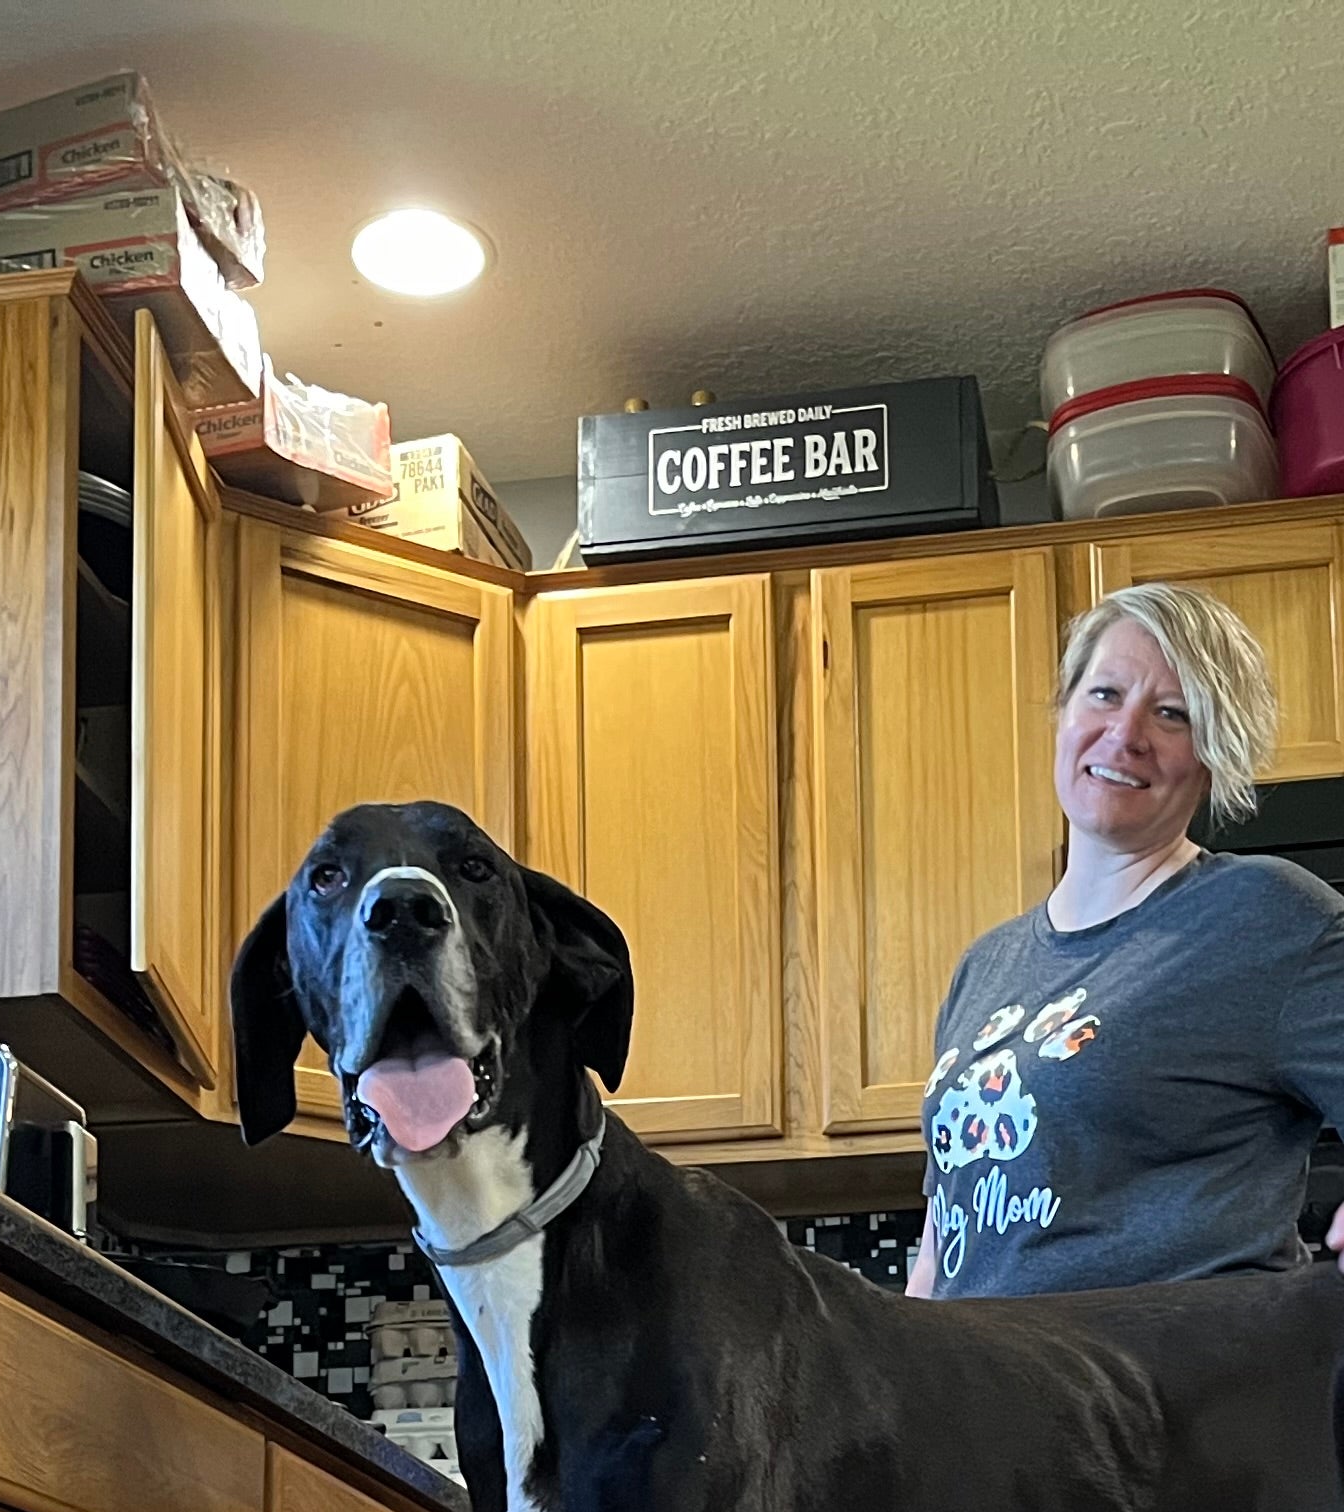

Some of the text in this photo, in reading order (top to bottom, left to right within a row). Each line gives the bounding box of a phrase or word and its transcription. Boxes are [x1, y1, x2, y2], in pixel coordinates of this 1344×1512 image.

[61, 138, 121, 165] Chicken
[89, 250, 155, 270] Chicken
[701, 404, 833, 434] FRESH BREWED DAILY
[400, 458, 444, 480] 78644
[657, 428, 880, 495] COFFEE BAR
[972, 1165, 1062, 1235] Mom
